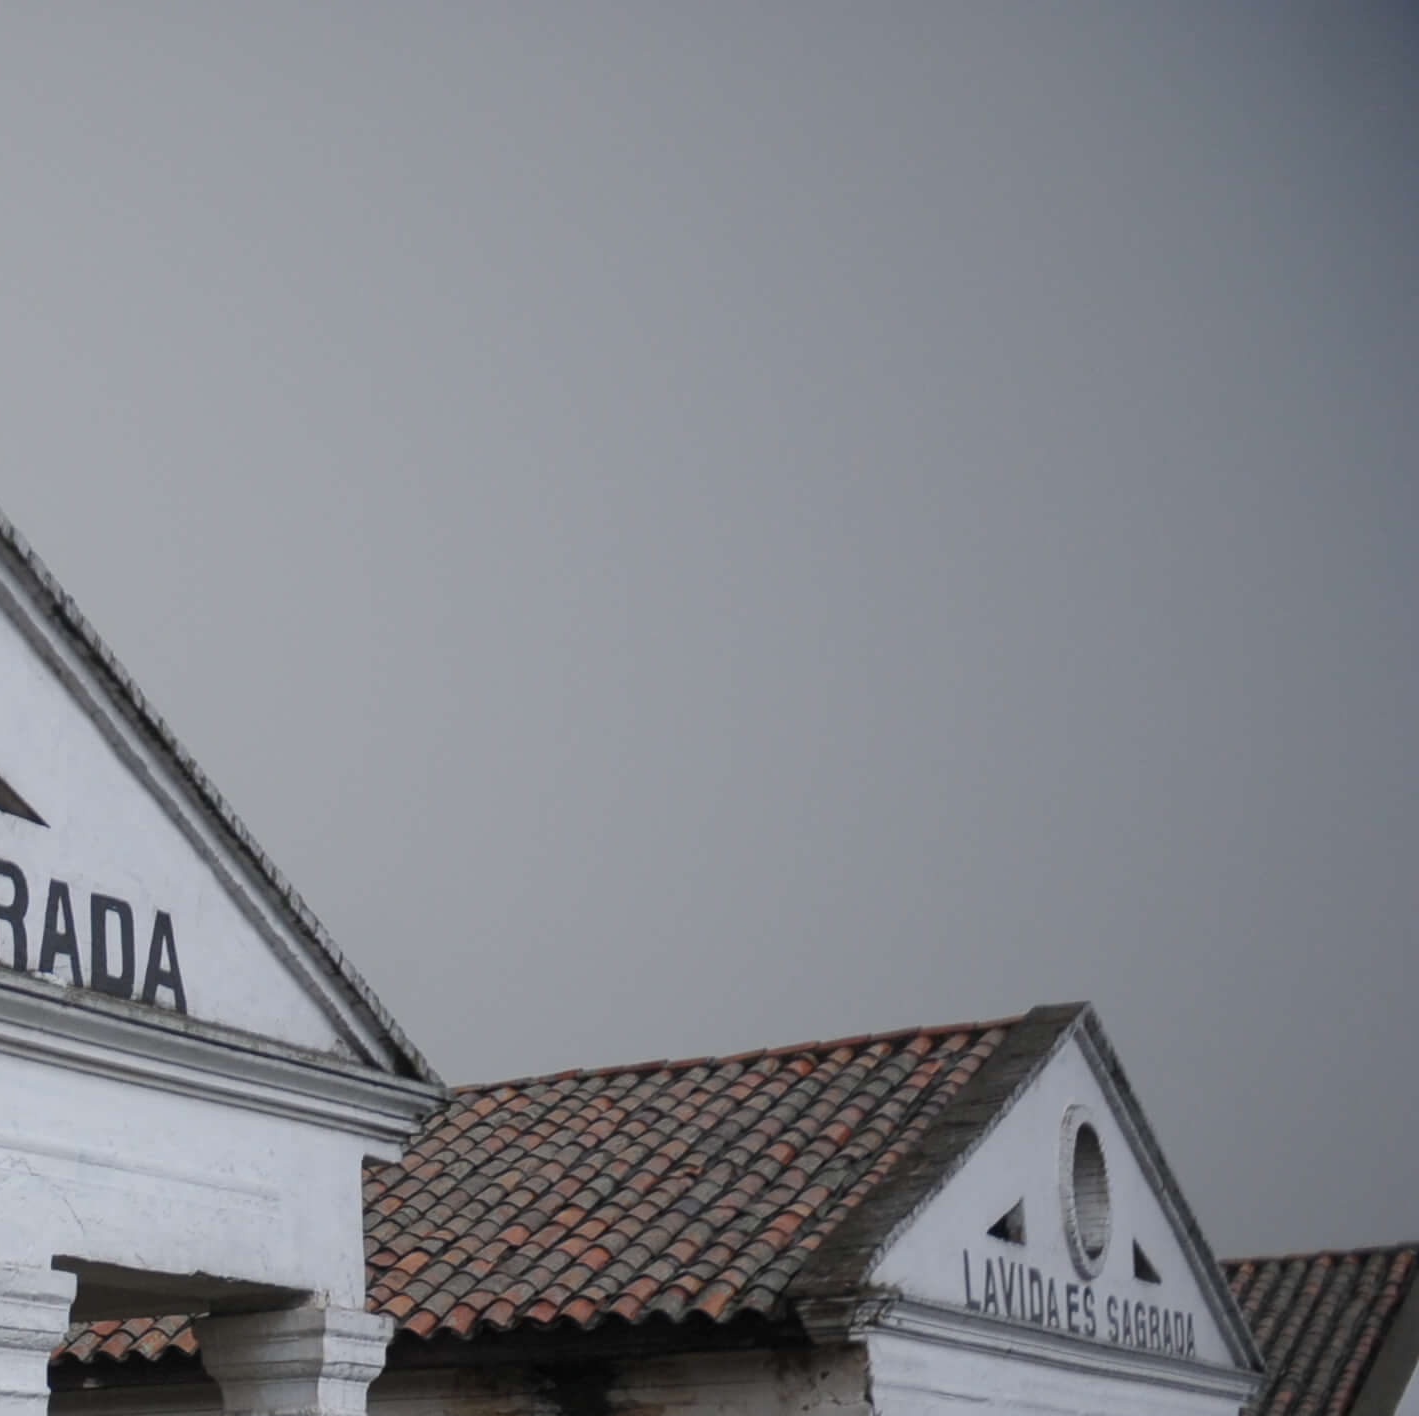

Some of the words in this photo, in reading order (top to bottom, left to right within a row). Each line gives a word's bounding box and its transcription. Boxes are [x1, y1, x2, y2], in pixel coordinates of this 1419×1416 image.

[963, 1248, 999, 1316] LA
[998, 1255, 1060, 1329] VIDA
[1066, 1283, 1096, 1337] ES
[1107, 1295, 1196, 1356] SAGRADA
